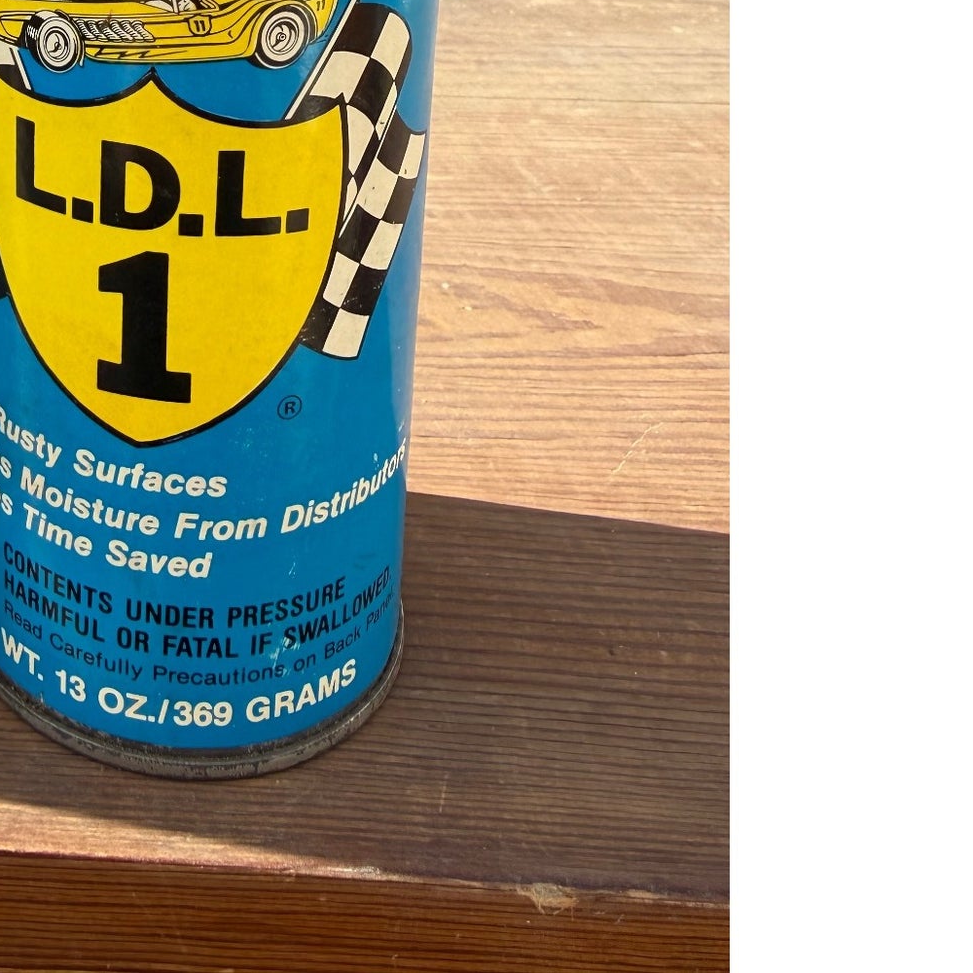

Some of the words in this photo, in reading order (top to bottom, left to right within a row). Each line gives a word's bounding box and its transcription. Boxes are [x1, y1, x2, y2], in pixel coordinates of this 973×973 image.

[16, 115, 310, 238] L.D.L.
[96, 250, 192, 404] 1
[20, 465, 160, 536] Moisture
[173, 511, 268, 541] From
[73, 448, 228, 498] Surfaces
[23, 502, 93, 557] Time
[105, 539, 213, 579] Saved
[3, 541, 113, 615] CONTENTS
[126, 598, 215, 629] UNDER
[227, 575, 346, 628] PRESSURE
[3, 569, 106, 643] HARMFUL
[117, 626, 150, 653] OR
[163, 635, 239, 659] FATAL
[250, 632, 274, 656] IF
[0, 626, 44, 681] WT.
[55, 669, 87, 702] 13
[246, 658, 357, 723] GRAMS
[4, 599, 43, 640] Read
[49, 632, 143, 681] Carefully
[153, 661, 286, 687] Precautions
[293, 653, 317, 672] on
[324, 628, 361, 659] Back
